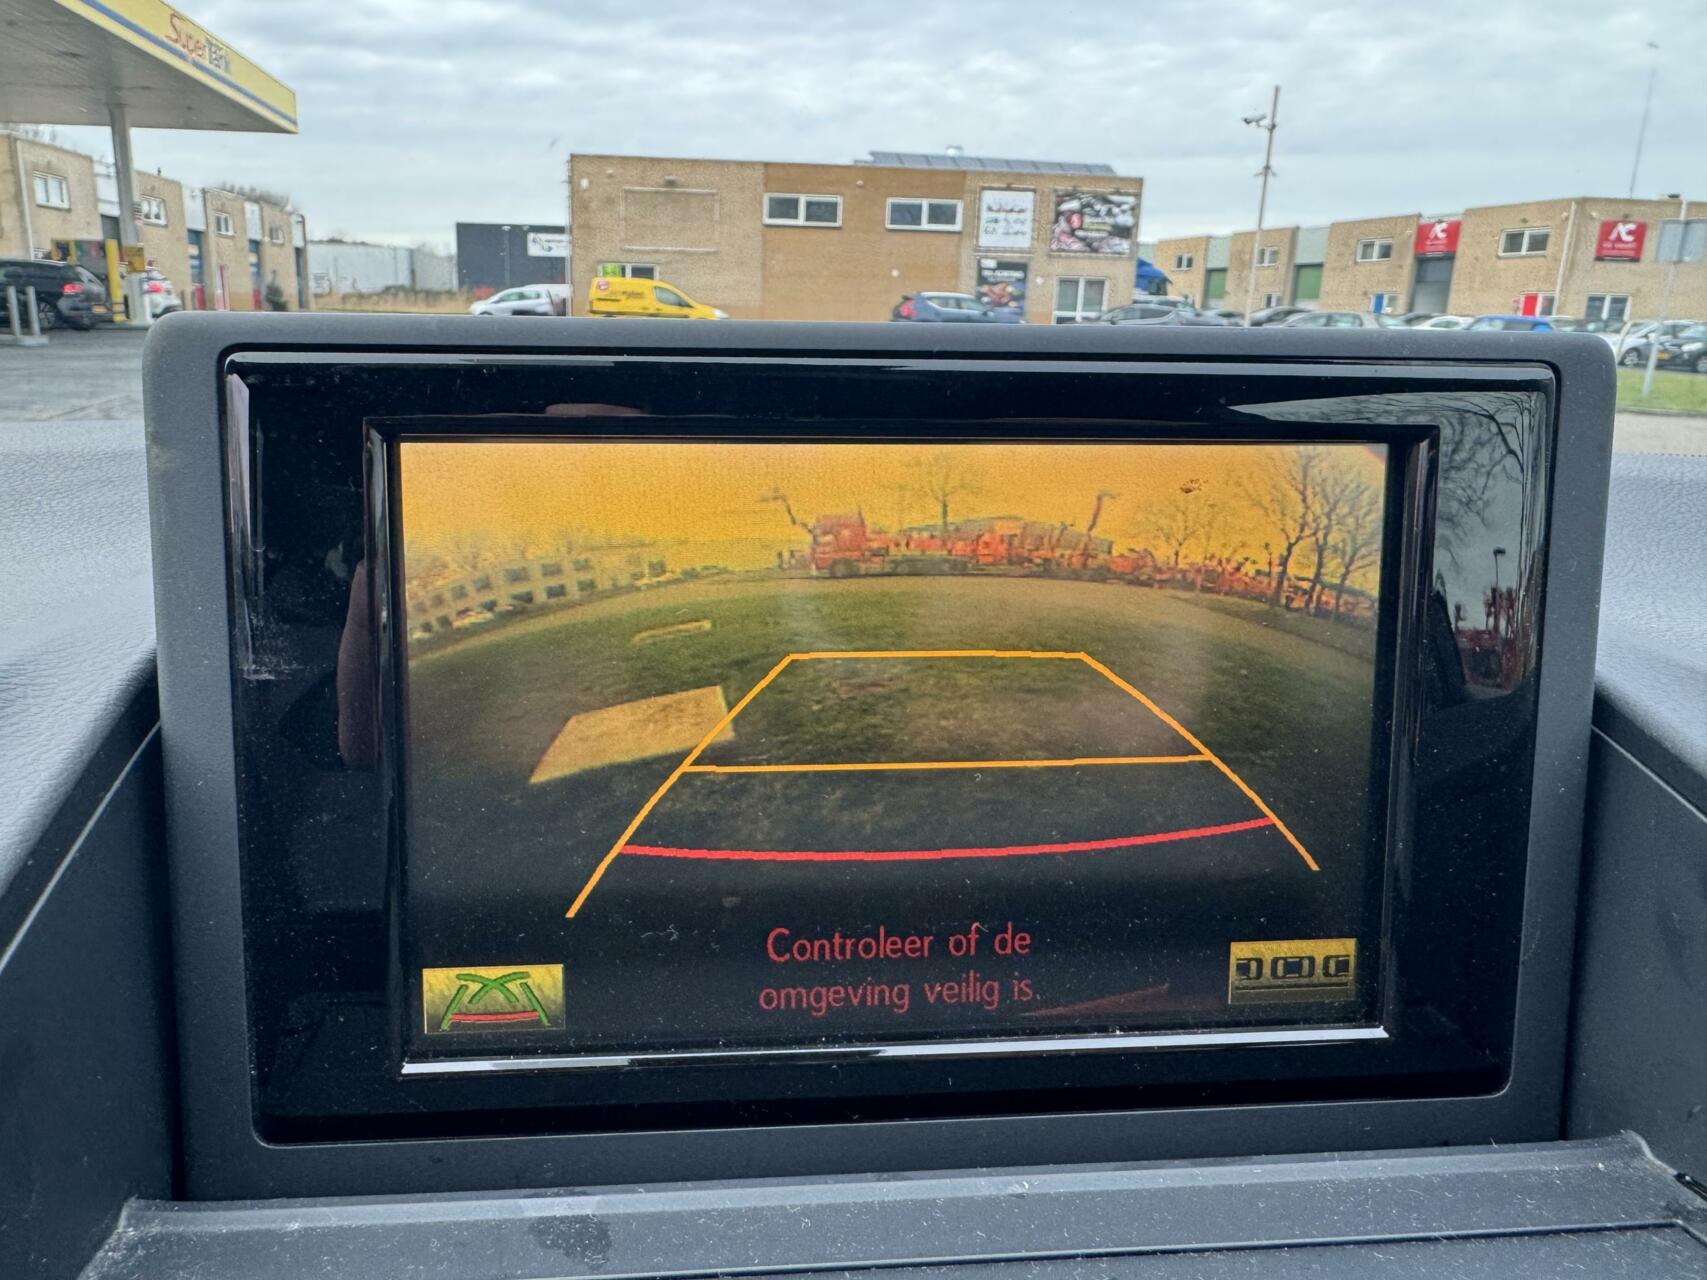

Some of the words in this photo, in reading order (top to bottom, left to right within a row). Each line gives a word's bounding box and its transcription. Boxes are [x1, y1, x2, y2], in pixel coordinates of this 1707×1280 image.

[766, 925, 934, 962] Controleer
[948, 921, 980, 957] of
[993, 920, 1031, 955] de
[759, 977, 910, 1015] omgeving
[923, 969, 1000, 1010] veilig
